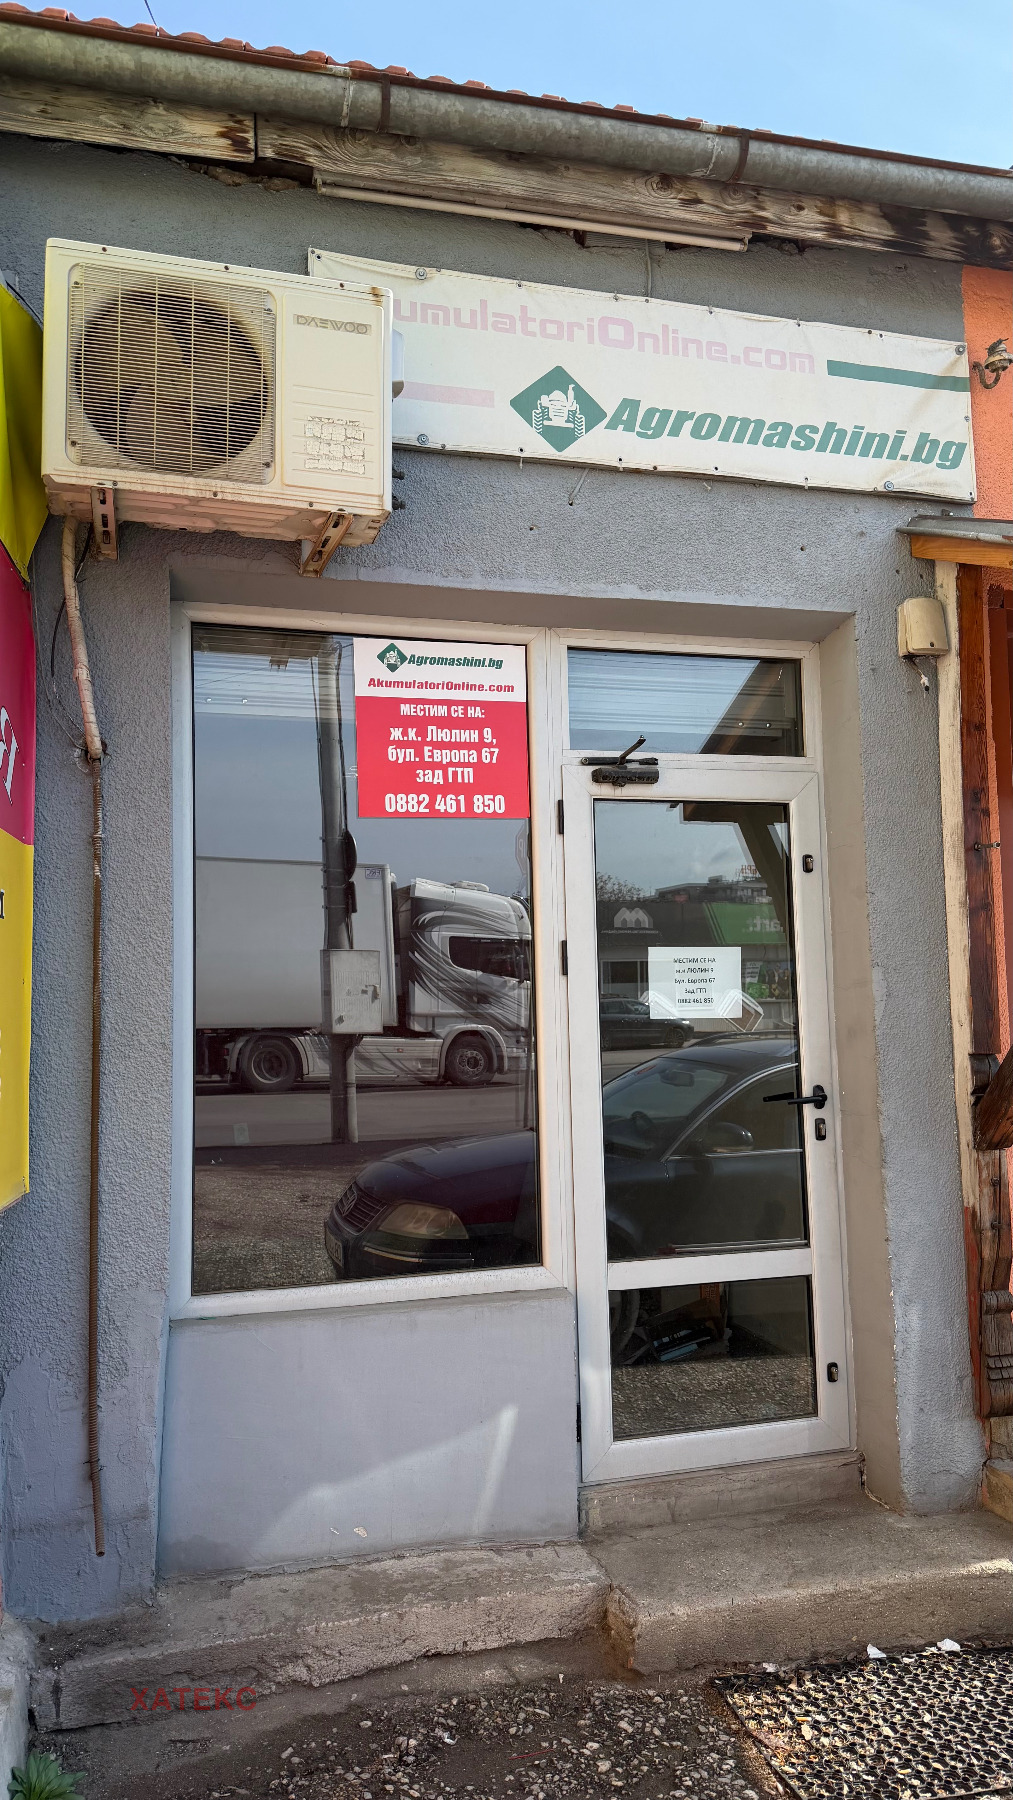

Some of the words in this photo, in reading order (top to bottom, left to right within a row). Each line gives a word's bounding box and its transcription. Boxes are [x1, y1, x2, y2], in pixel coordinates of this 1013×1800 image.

[296, 314, 368, 335] DAEWOO
[393, 298, 816, 375] umulatoriOnline.com
[604, 397, 967, 470] Agromashini.bg
[407, 653, 504, 670] Agromashini.bg
[368, 677, 515, 693] AkumulatoriOnline.com
[400, 703, 448, 717] МЕСТИМ
[451, 705, 465, 718] СЕ
[467, 706, 486, 719] НА:
[389, 727, 422, 742] ж.к.
[426, 725, 479, 743] Люлин
[483, 727, 497, 745] 9,
[387, 744, 420, 764] бул.
[423, 746, 478, 765] Европа
[481, 747, 500, 764] 67
[415, 768, 444, 785] зад
[448, 766, 474, 784] ГТП
[384, 793, 430, 813] 0882
[435, 794, 466, 813] 461
[473, 794, 506, 814] 850
